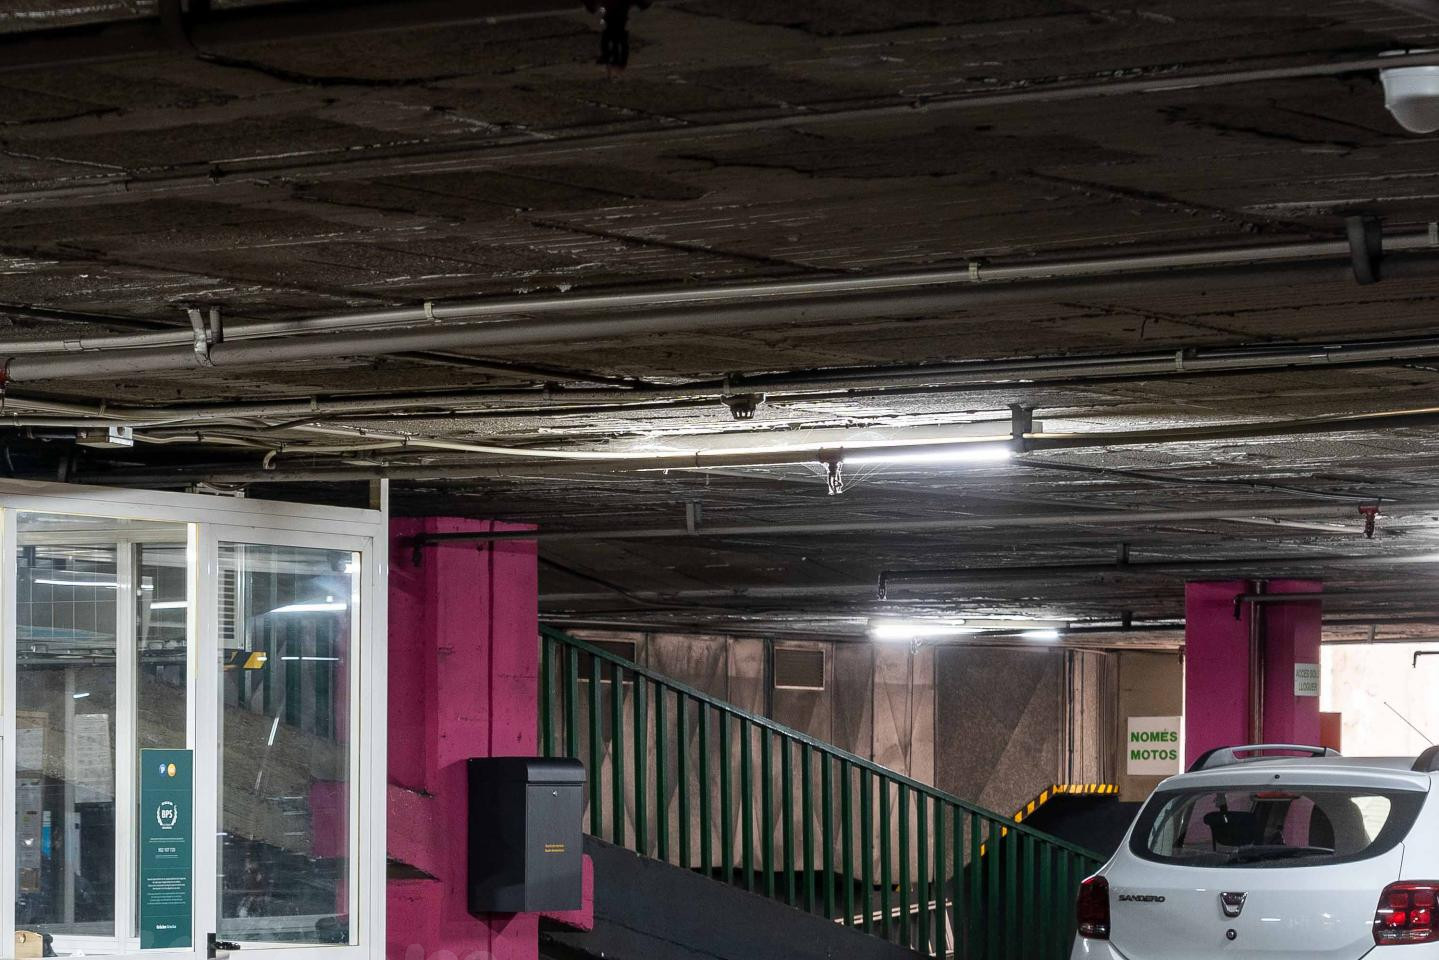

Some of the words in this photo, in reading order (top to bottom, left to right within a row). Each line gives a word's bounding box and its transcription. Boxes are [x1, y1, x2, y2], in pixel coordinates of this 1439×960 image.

[1130, 729, 1178, 743] NOMÉS
[1130, 750, 1178, 761] MOTOS
[1119, 894, 1166, 903] SANDERO
